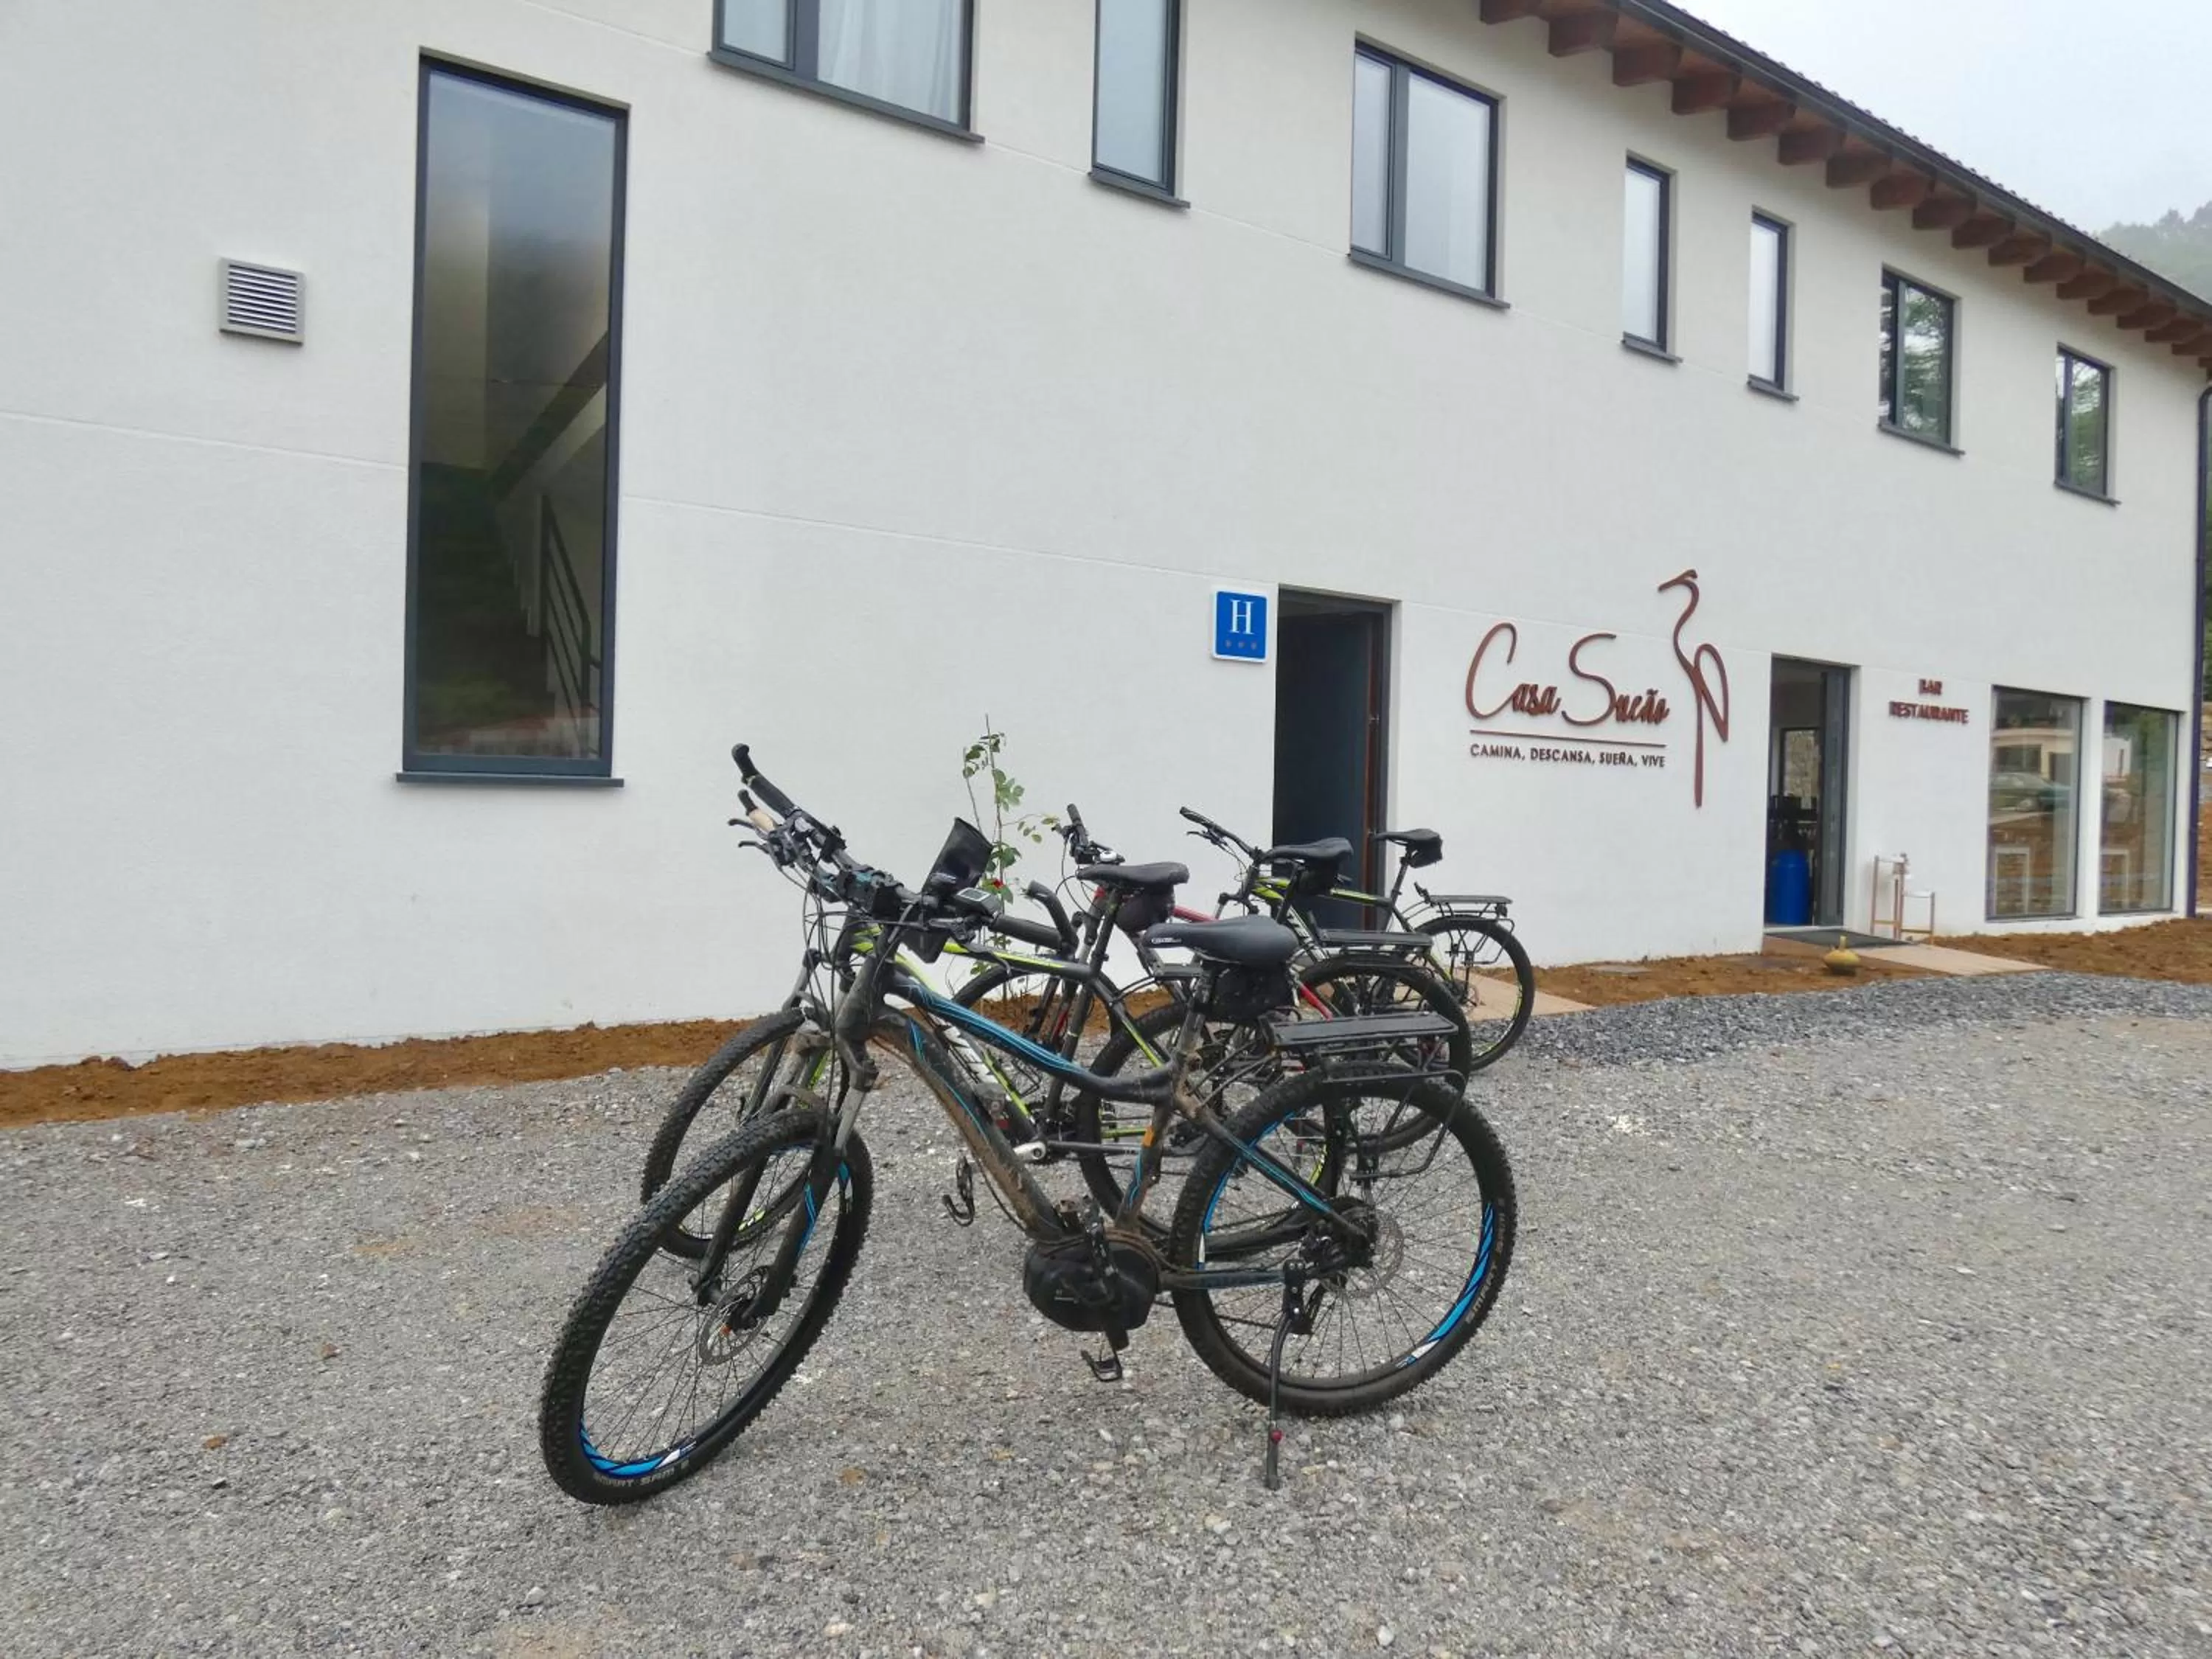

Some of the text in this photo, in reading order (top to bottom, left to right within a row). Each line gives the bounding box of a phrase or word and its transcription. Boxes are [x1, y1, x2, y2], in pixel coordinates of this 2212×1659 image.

[1229, 598, 1255, 635] H
[1466, 622, 1670, 726] Casa Sueño
[1919, 678, 1942, 695] BAR
[1889, 700, 1969, 725] RESTAURANTE
[1470, 743, 1666, 768] CAMINA, DESCANSA, SUEÑA, VIVE
